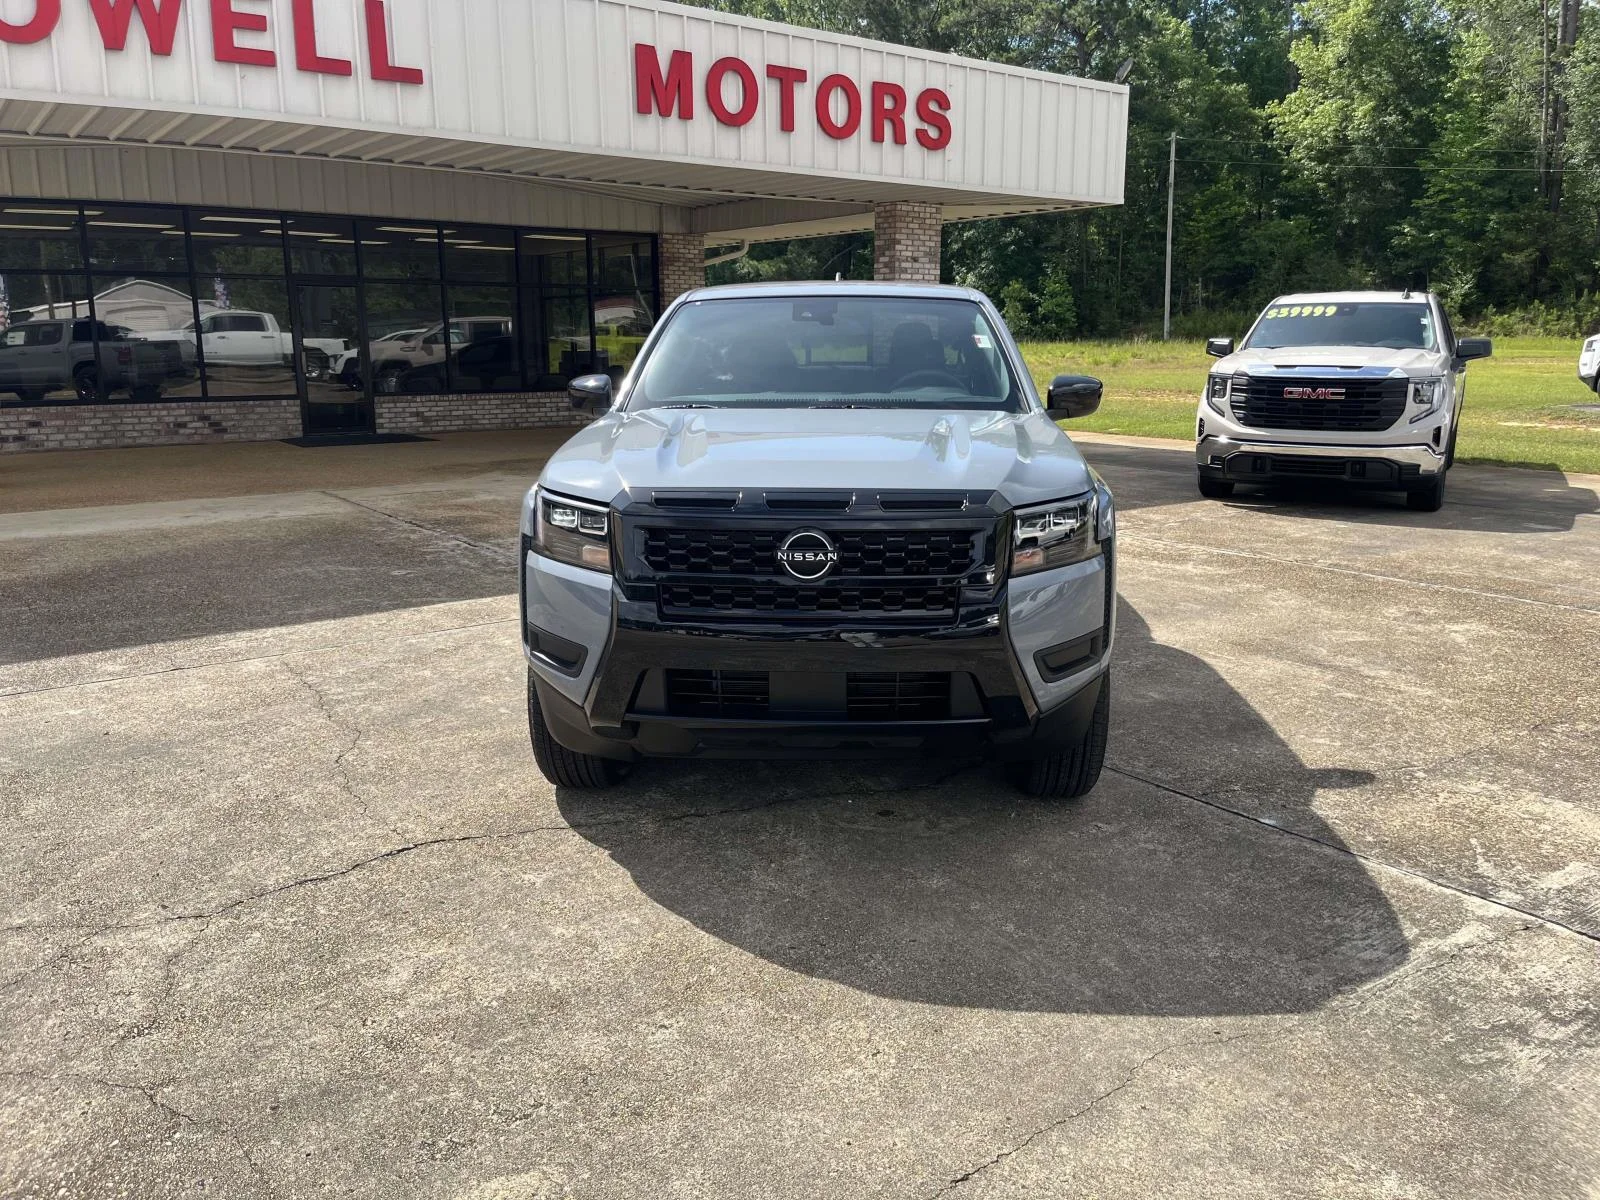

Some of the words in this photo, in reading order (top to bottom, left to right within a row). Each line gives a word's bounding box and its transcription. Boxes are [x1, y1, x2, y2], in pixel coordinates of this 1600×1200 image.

[634, 43, 951, 150] MOTORS
[1283, 387, 1346, 400] GMC
[777, 551, 837, 561] NISSAN
